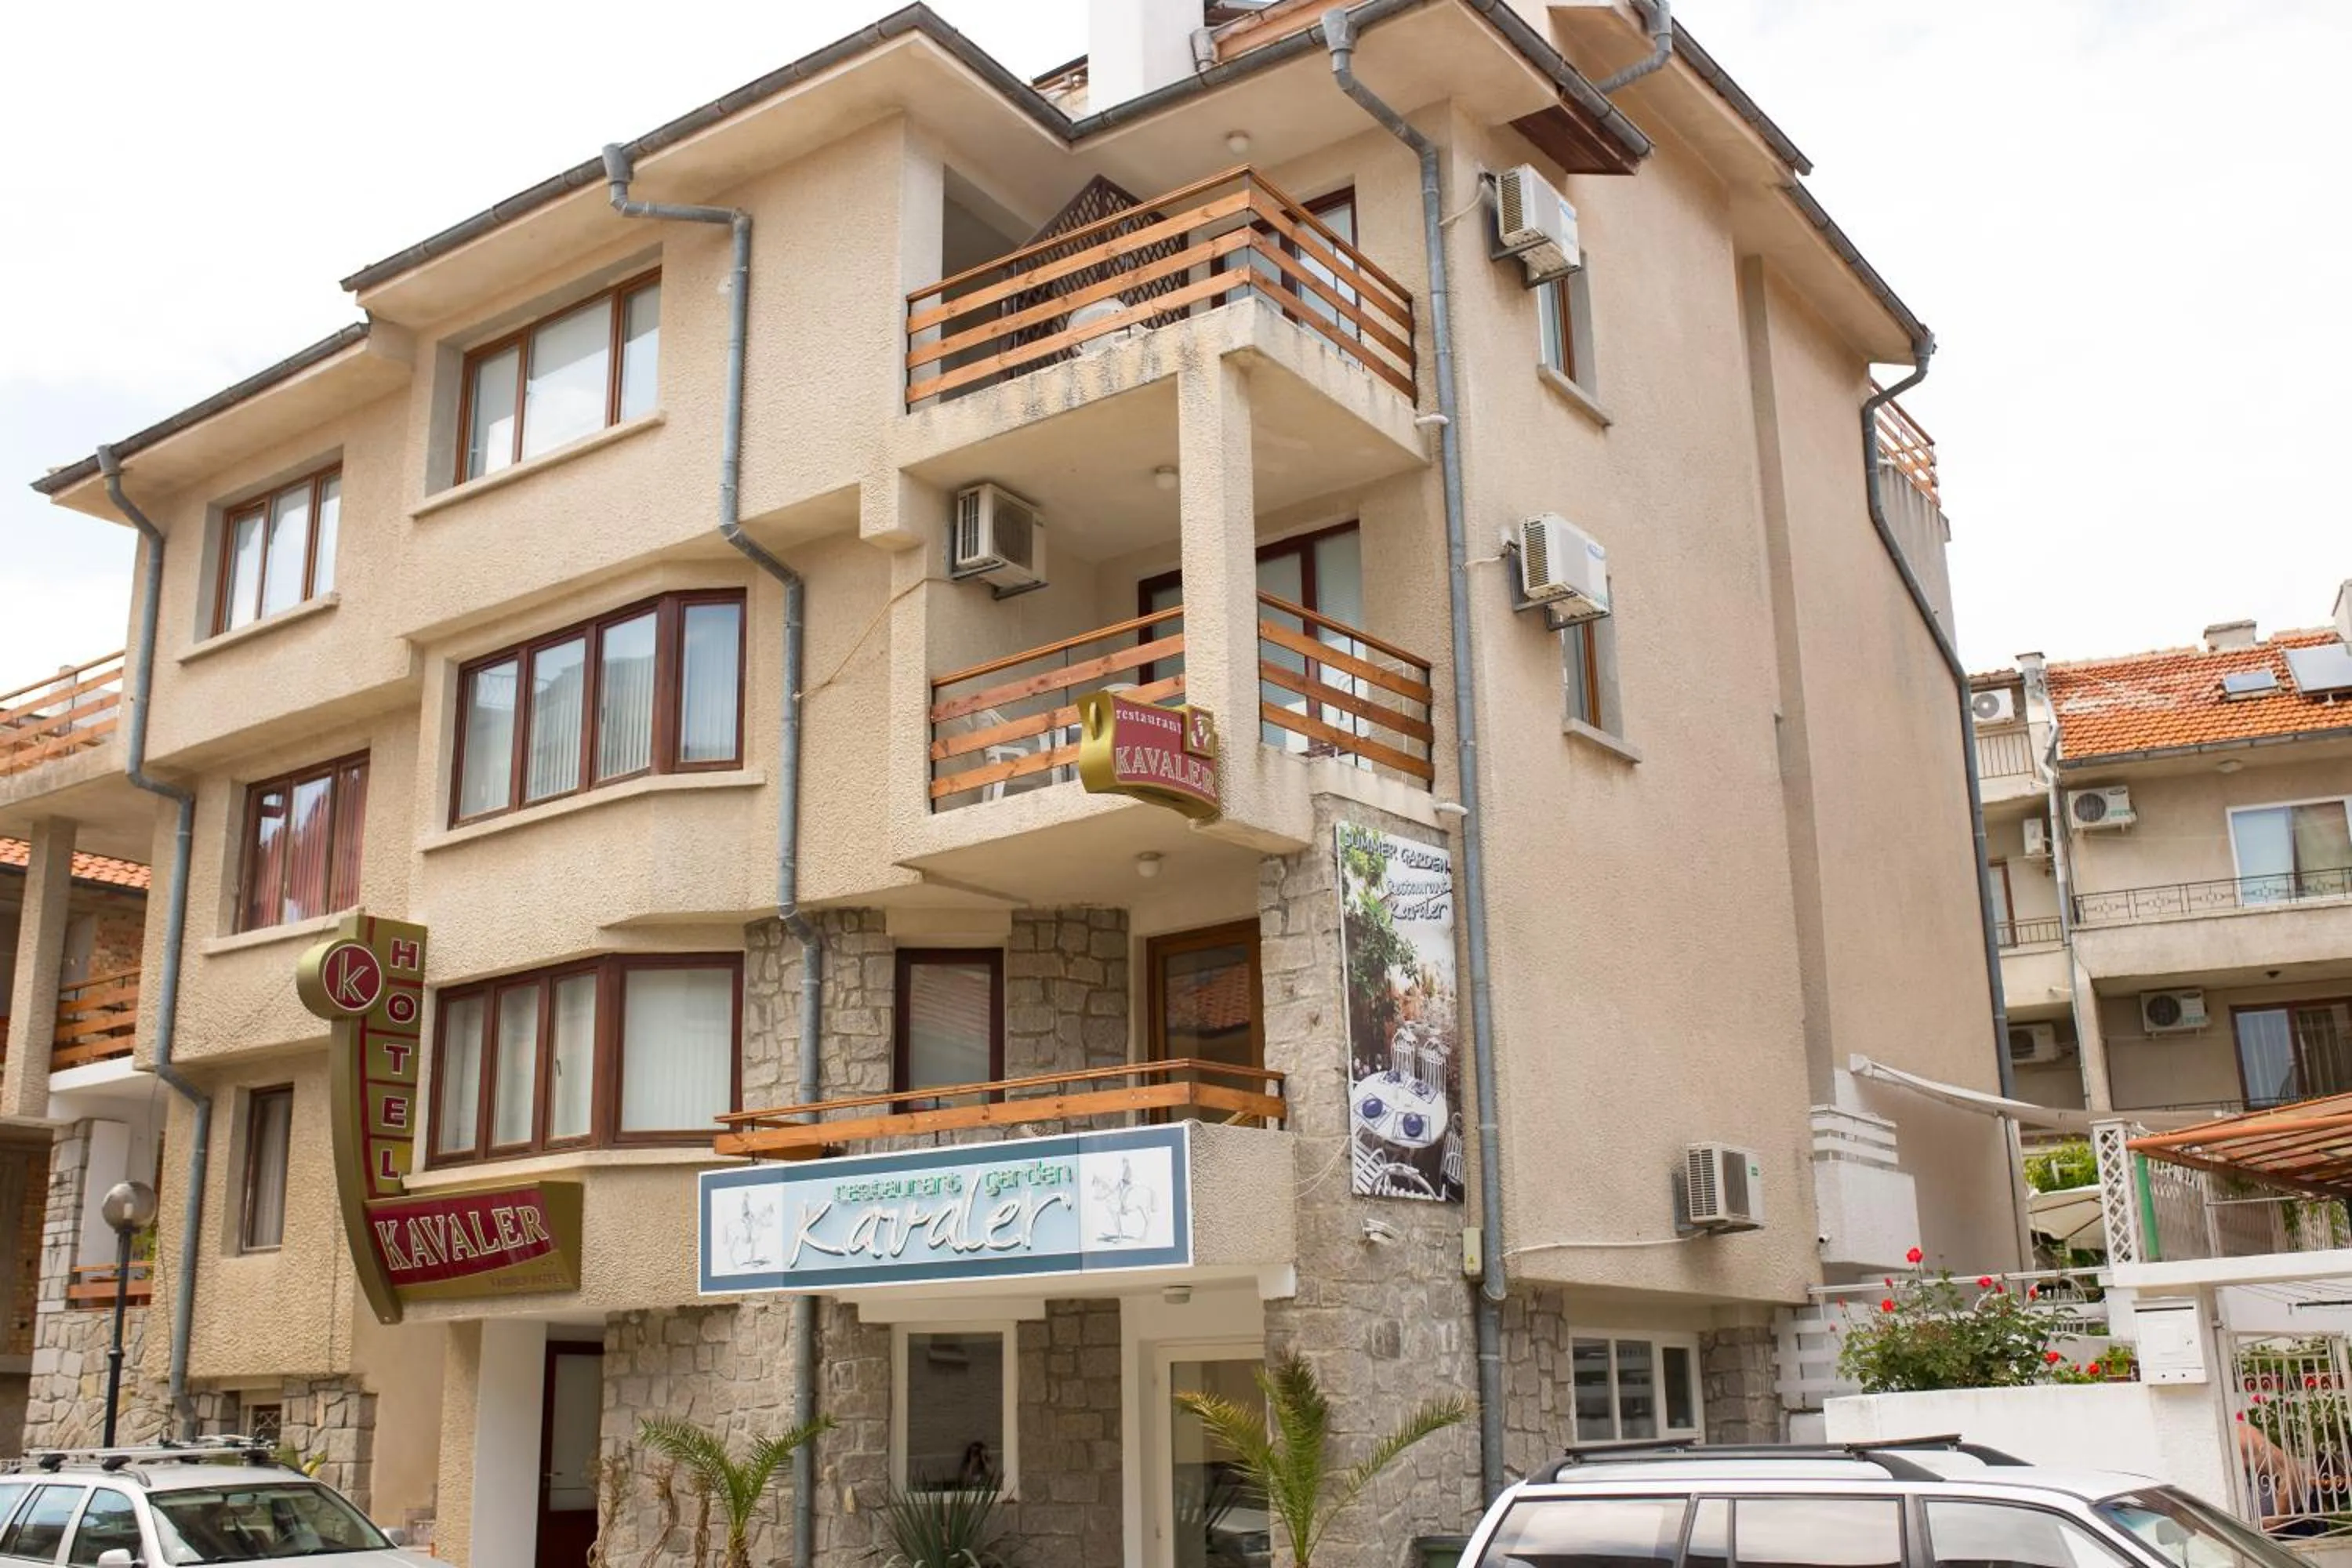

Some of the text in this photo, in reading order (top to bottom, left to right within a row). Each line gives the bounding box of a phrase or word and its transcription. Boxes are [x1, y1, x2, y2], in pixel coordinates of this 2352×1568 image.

[1116, 709, 1182, 735] restaurant
[1116, 746, 1217, 797] KAVALER
[1344, 831, 1451, 875] SUMMER GARDEN
[379, 938, 419, 1179] HOTEL
[835, 1160, 1073, 1201] restaurant garden
[374, 1205, 550, 1271] KAVALER
